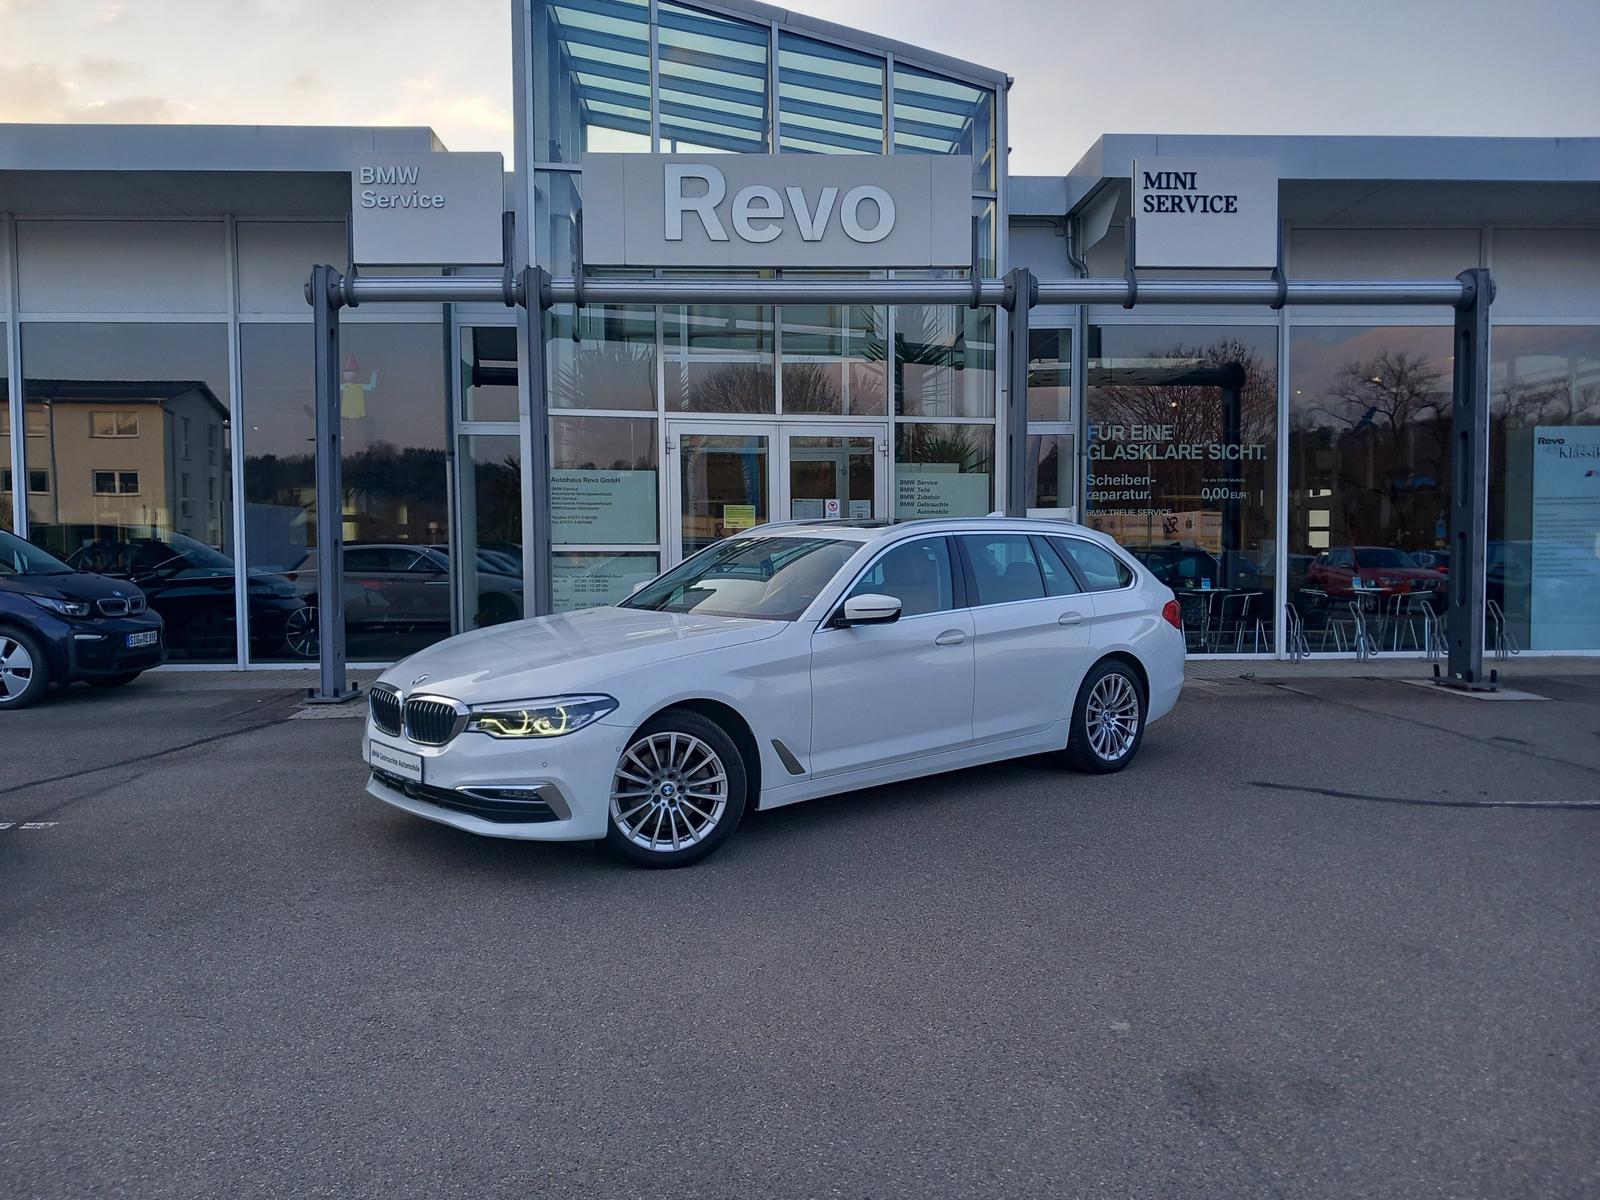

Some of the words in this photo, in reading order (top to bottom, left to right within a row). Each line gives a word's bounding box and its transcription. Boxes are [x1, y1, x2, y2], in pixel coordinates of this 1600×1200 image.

[359, 166, 420, 185] BMW
[1143, 171, 1198, 190] MINI
[360, 190, 446, 209] Service
[663, 162, 897, 244] Revo
[1143, 195, 1238, 214] SERVICE
[1087, 421, 1126, 441] FÜR
[1131, 424, 1174, 441] EINE
[1538, 437, 1565, 445] Revo
[1087, 443, 1204, 461] GLASKLARE
[1208, 443, 1268, 461] SICHT.
[551, 476, 582, 484] Autohaus
[1086, 473, 1157, 487] Scheiben-
[1201, 487, 1230, 504] 0,00
[1137, 508, 1172, 517] SERVICE
